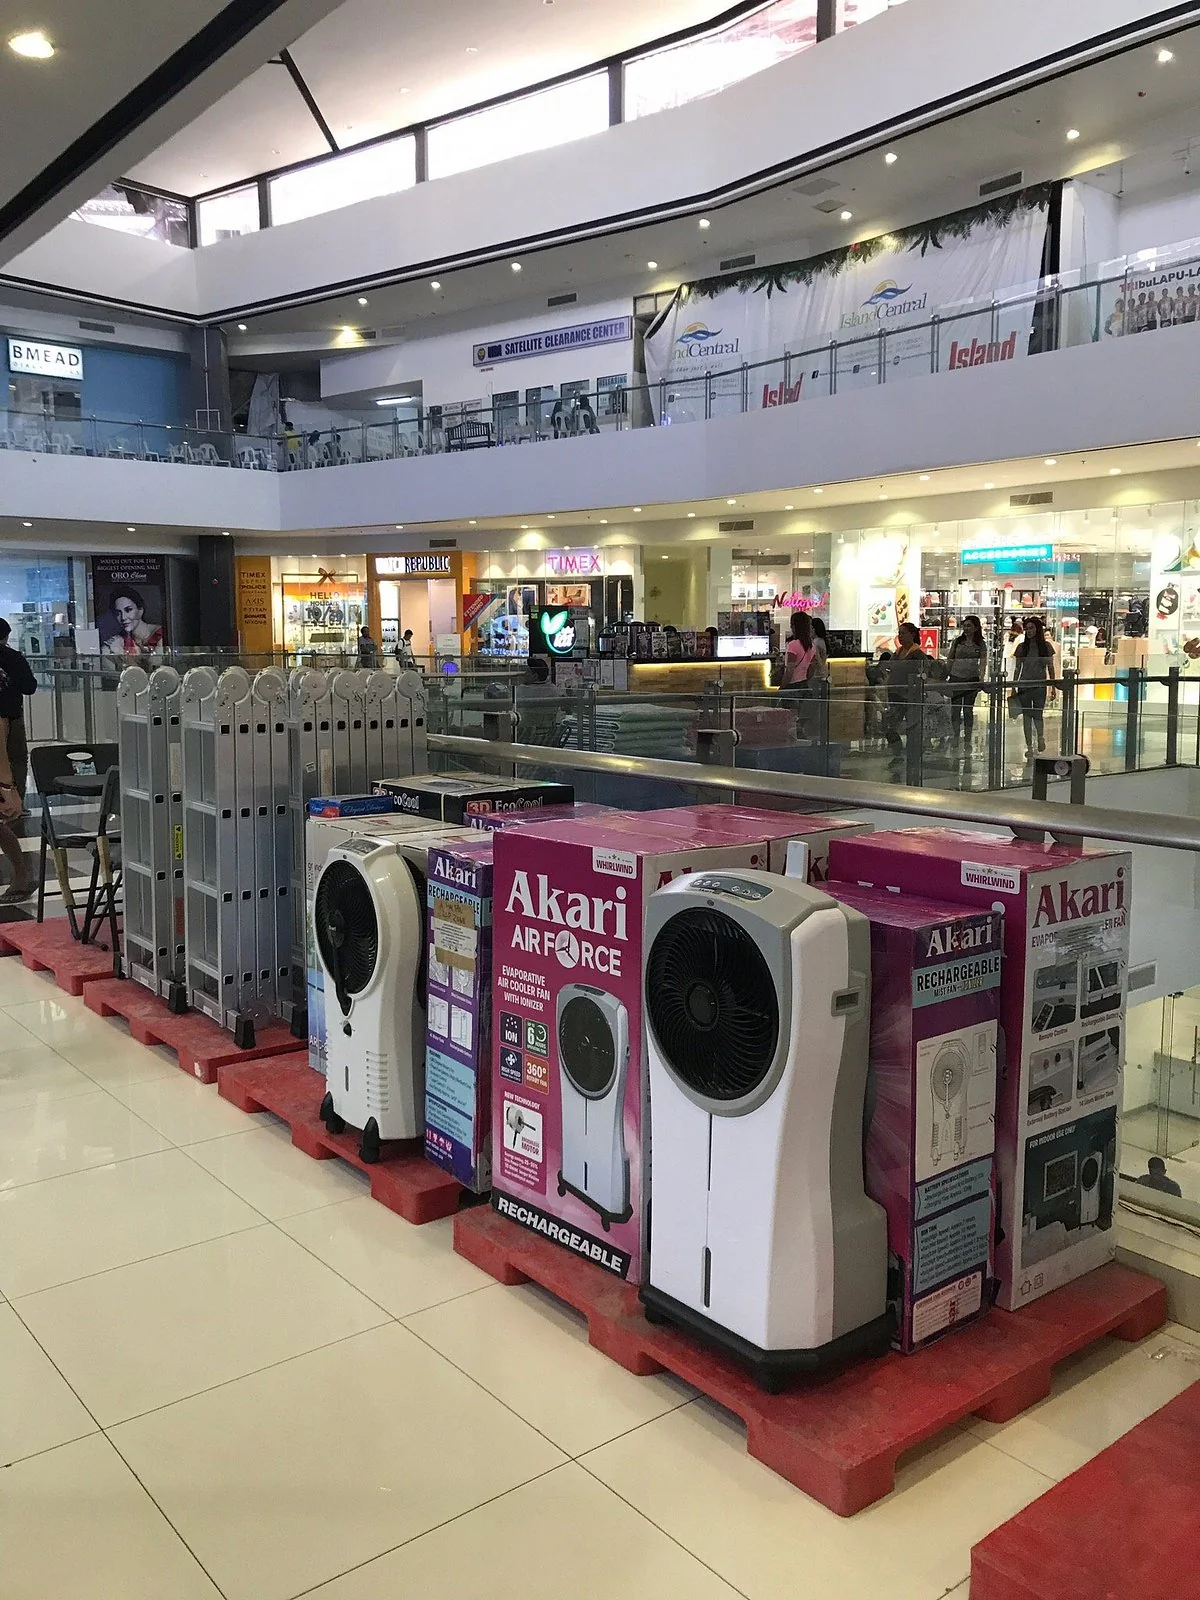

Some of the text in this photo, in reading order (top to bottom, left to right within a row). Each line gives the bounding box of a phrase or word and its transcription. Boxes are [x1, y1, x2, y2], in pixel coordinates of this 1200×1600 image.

[504, 337, 543, 356] SATELLITE
[544, 328, 591, 348] CLEARANCE
[592, 321, 625, 341] CENTER
[12, 345, 80, 367] BMEAD
[949, 330, 1017, 371] Island
[405, 555, 451, 573] REPUBLIC
[548, 555, 601, 572] TIMEX
[111, 571, 129, 579] ORO
[240, 571, 266, 579] TIMEX
[389, 791, 420, 810] coCool
[433, 856, 477, 889] Akari
[596, 859, 634, 875] WHIRLWIND
[965, 872, 1015, 890] WHIRLWIND
[504, 869, 629, 941] Akari
[1032, 867, 1125, 929] Akari
[926, 916, 993, 958] Akari
[502, 965, 546, 987] EVAPORATIVE
[916, 956, 1000, 992] RECHARGEABLE
[497, 976, 550, 1001] AIR COOLER FAN
[933, 987, 946, 997] MIST
[946, 984, 957, 993] FAN
[504, 991, 544, 1012] WITH IONIZER
[505, 1030, 518, 1043] ION
[527, 1026, 535, 1045] 6
[526, 1062, 547, 1078] 360°
[504, 1090, 541, 1111] NEW TECHNOLOGY
[1029, 1124, 1077, 1149] FOR INDOOR USE ONLY
[521, 1142, 540, 1156] MOTOR
[498, 1197, 623, 1273] RECHARGEABLE
